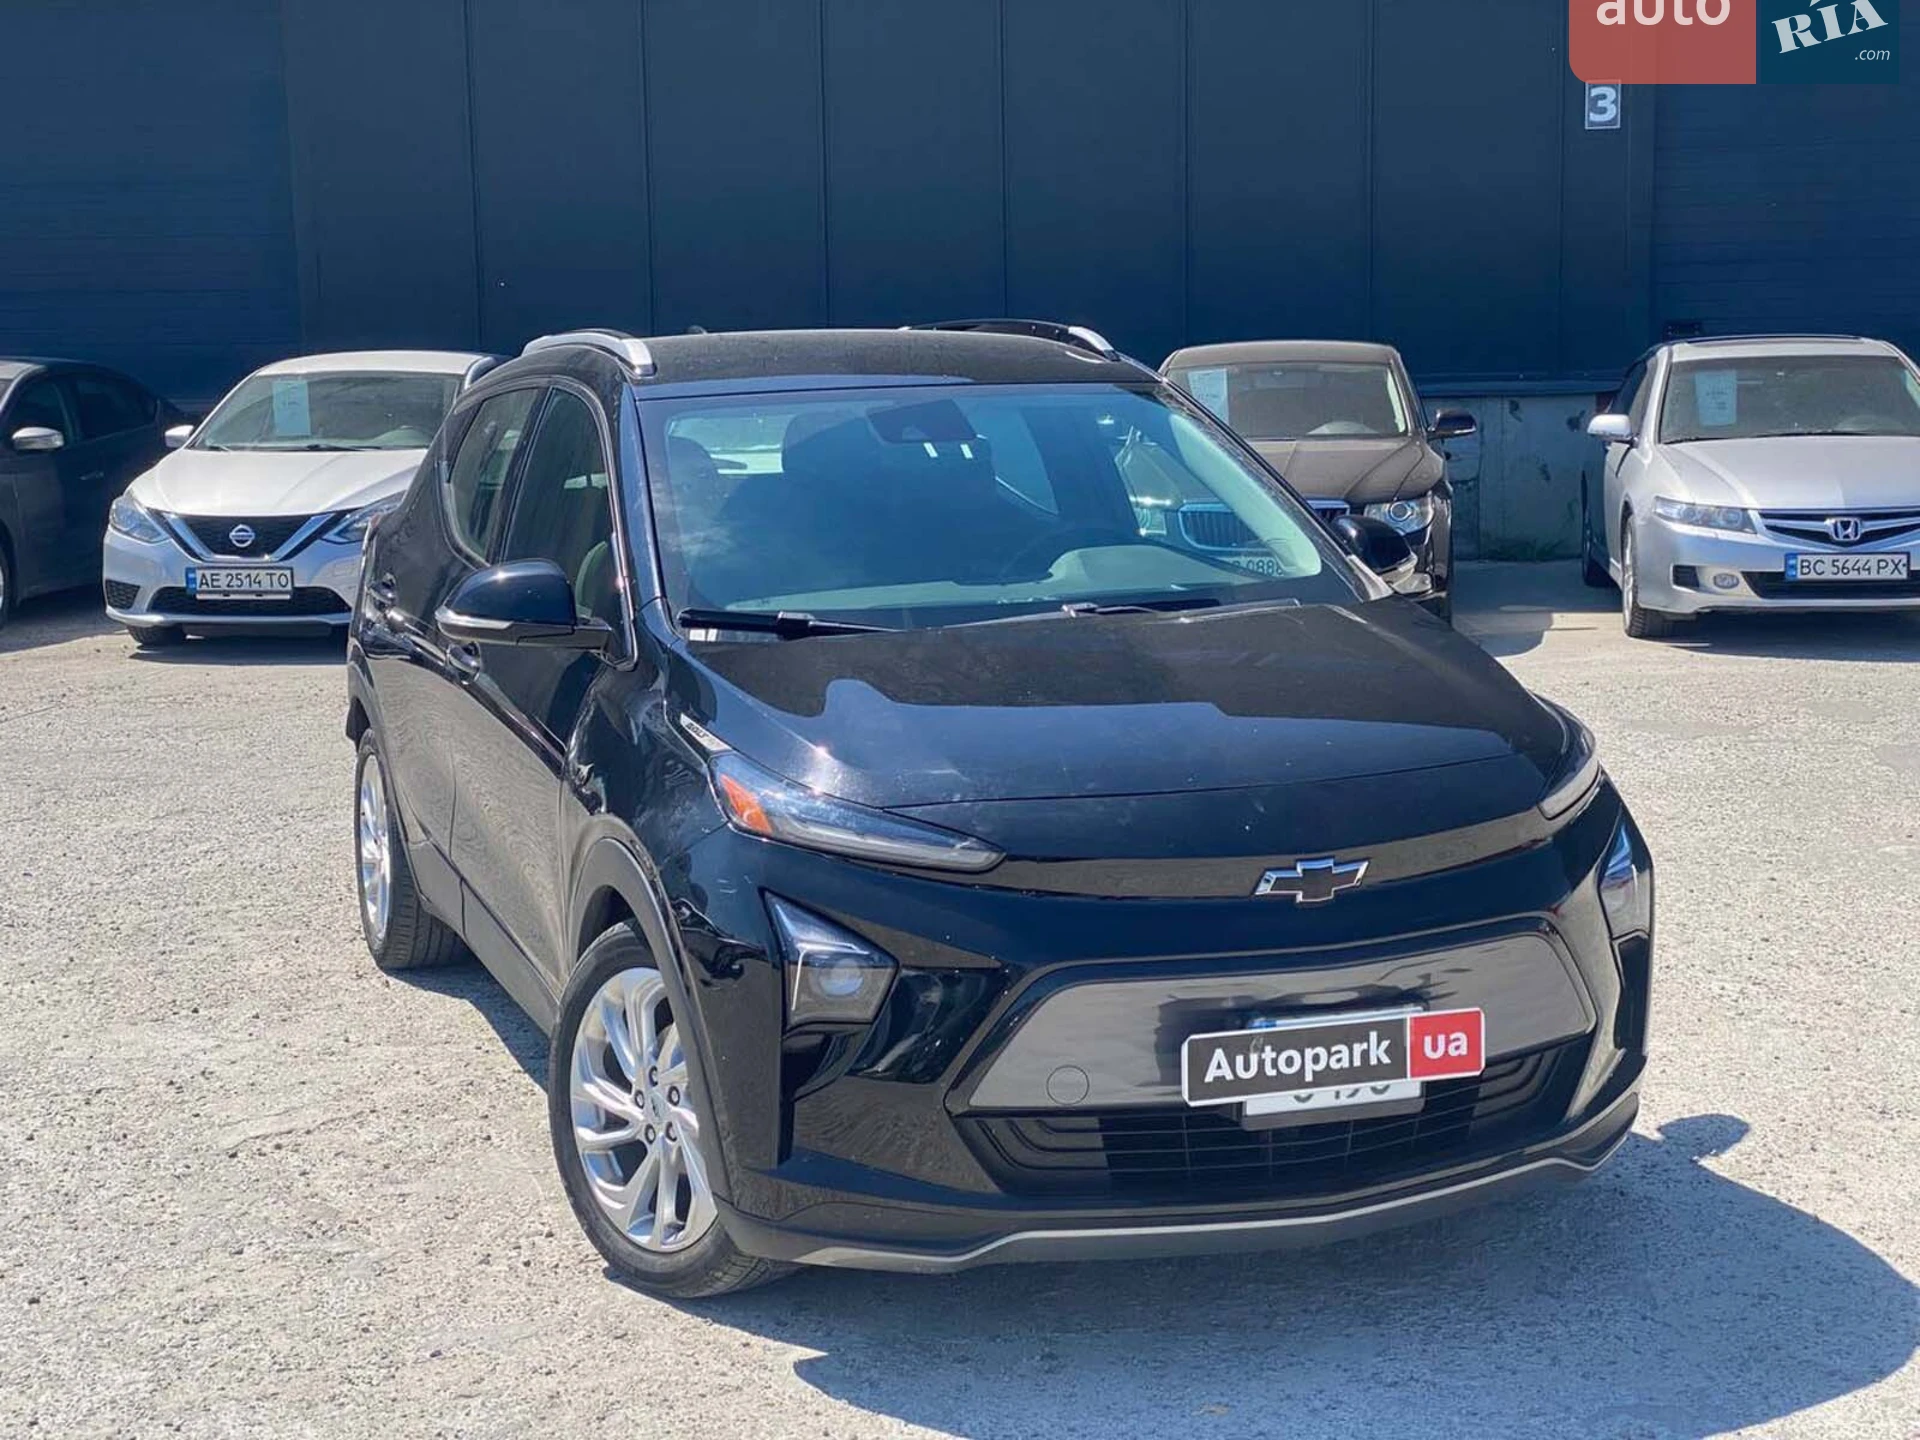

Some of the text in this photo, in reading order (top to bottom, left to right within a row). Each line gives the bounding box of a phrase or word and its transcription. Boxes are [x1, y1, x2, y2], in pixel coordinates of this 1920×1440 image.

[1588, 86, 1618, 122] 3
[199, 572, 222, 588] AE
[226, 572, 262, 588] 2514
[266, 572, 289, 588] TO
[1800, 559, 1825, 576] BC
[1831, 559, 1872, 576] 5644
[1876, 559, 1903, 576] PX
[1204, 1031, 1469, 1083] Autopark ua
